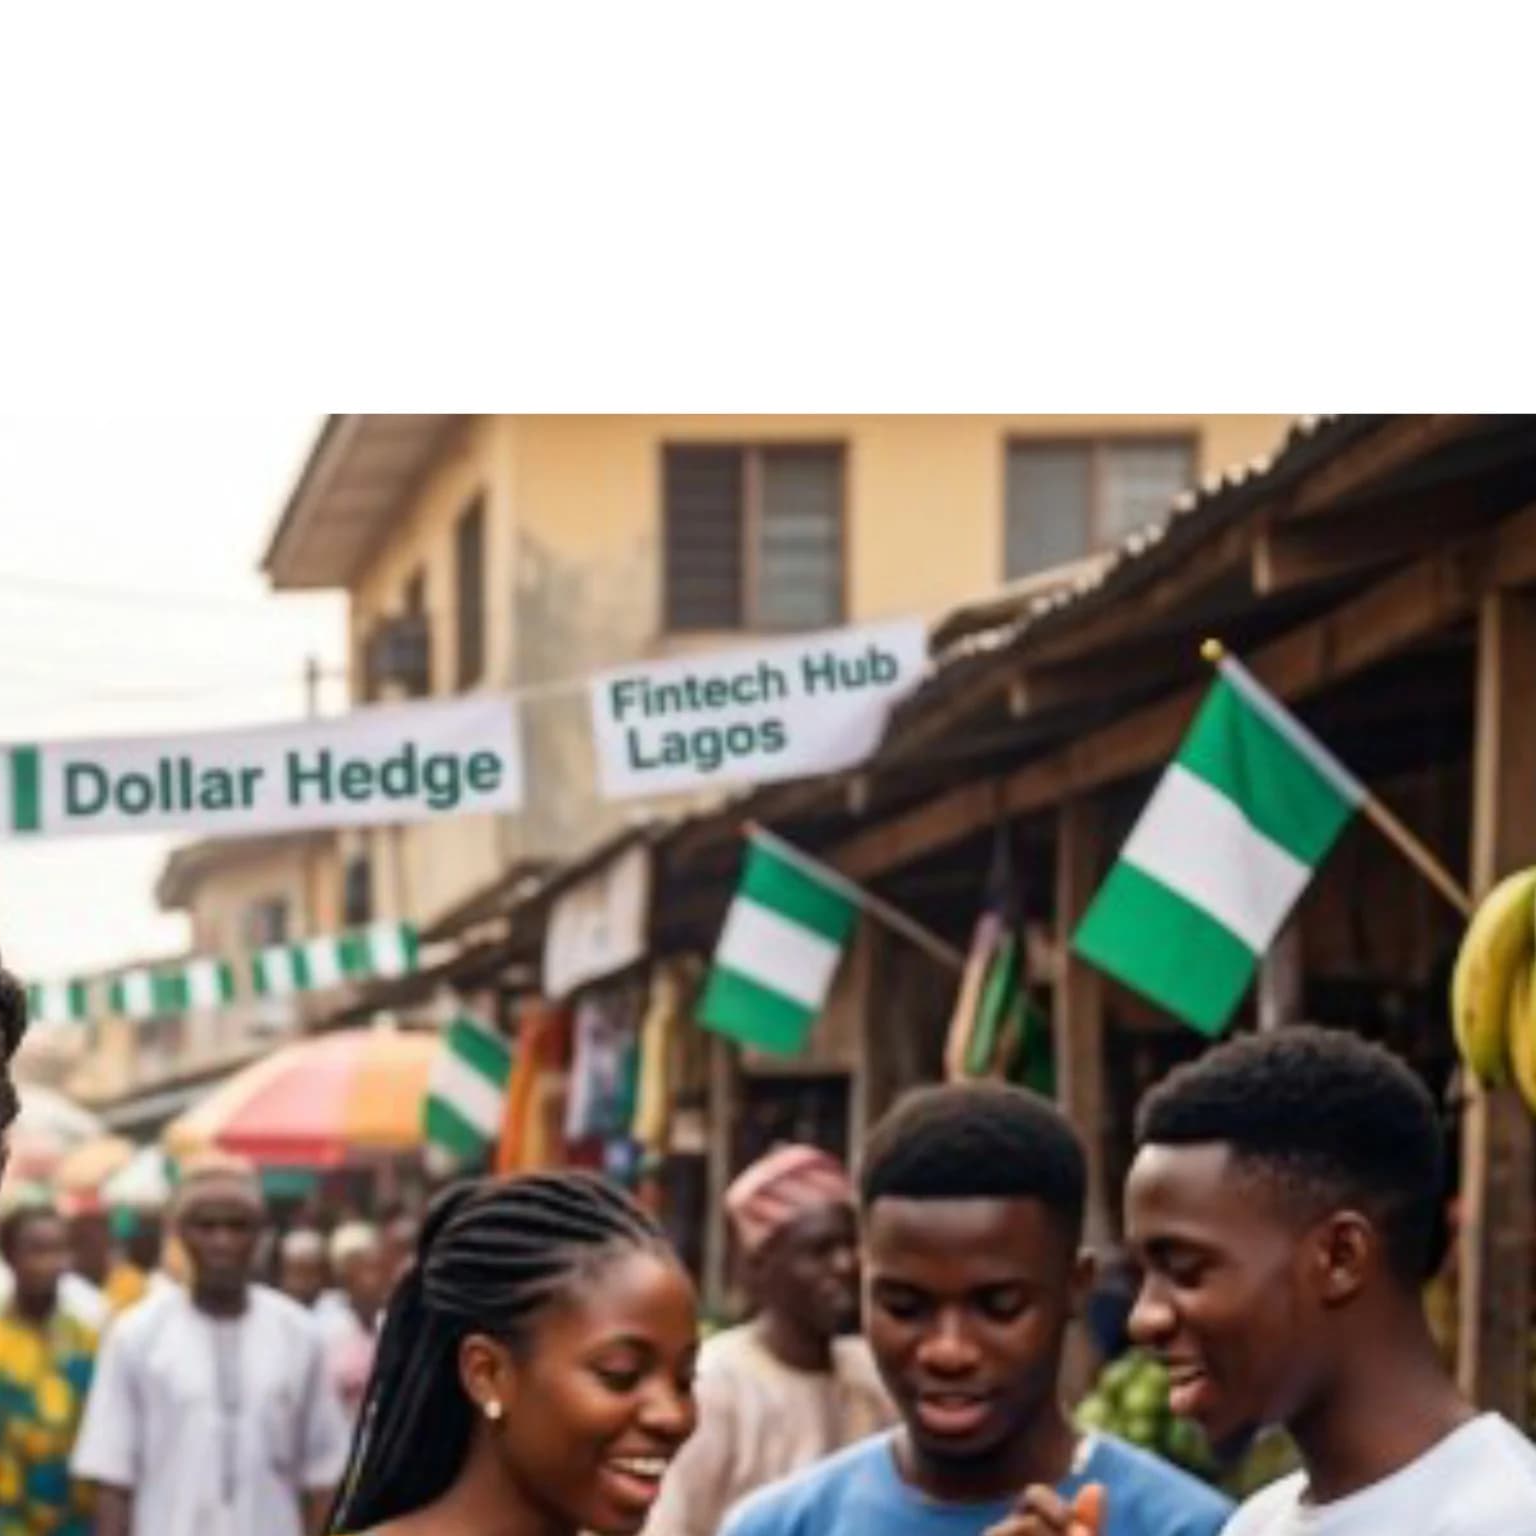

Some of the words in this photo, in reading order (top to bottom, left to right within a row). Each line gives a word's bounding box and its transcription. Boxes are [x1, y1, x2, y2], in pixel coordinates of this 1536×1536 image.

[610, 660, 790, 722] Fintech
[801, 643, 898, 696] Hub
[64, 756, 264, 816] Dollar
[288, 741, 504, 811] Hedge
[627, 718, 788, 773] Lagos
